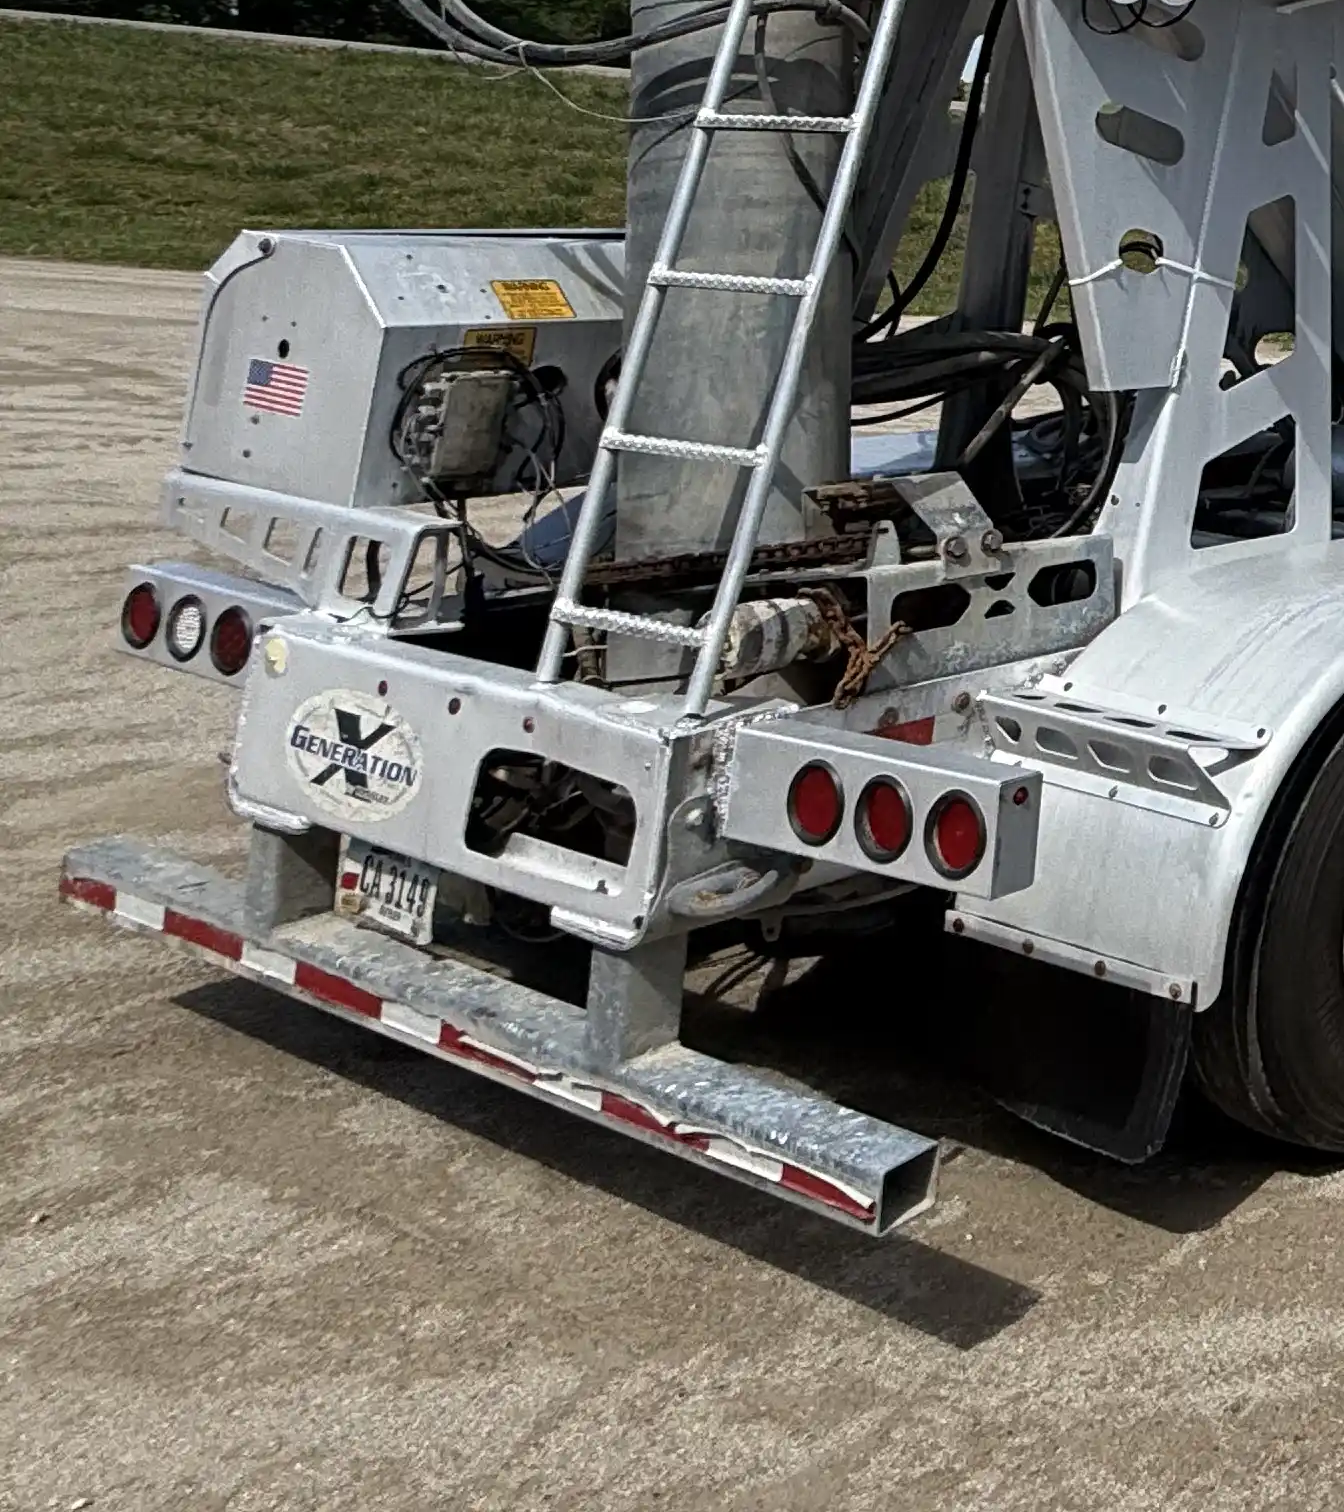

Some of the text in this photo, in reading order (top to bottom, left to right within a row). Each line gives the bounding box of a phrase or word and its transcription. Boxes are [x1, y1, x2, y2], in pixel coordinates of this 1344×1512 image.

[290, 724, 418, 787] GENERATION
[360, 854, 384, 900] CA
[384, 864, 431, 918] 3149
